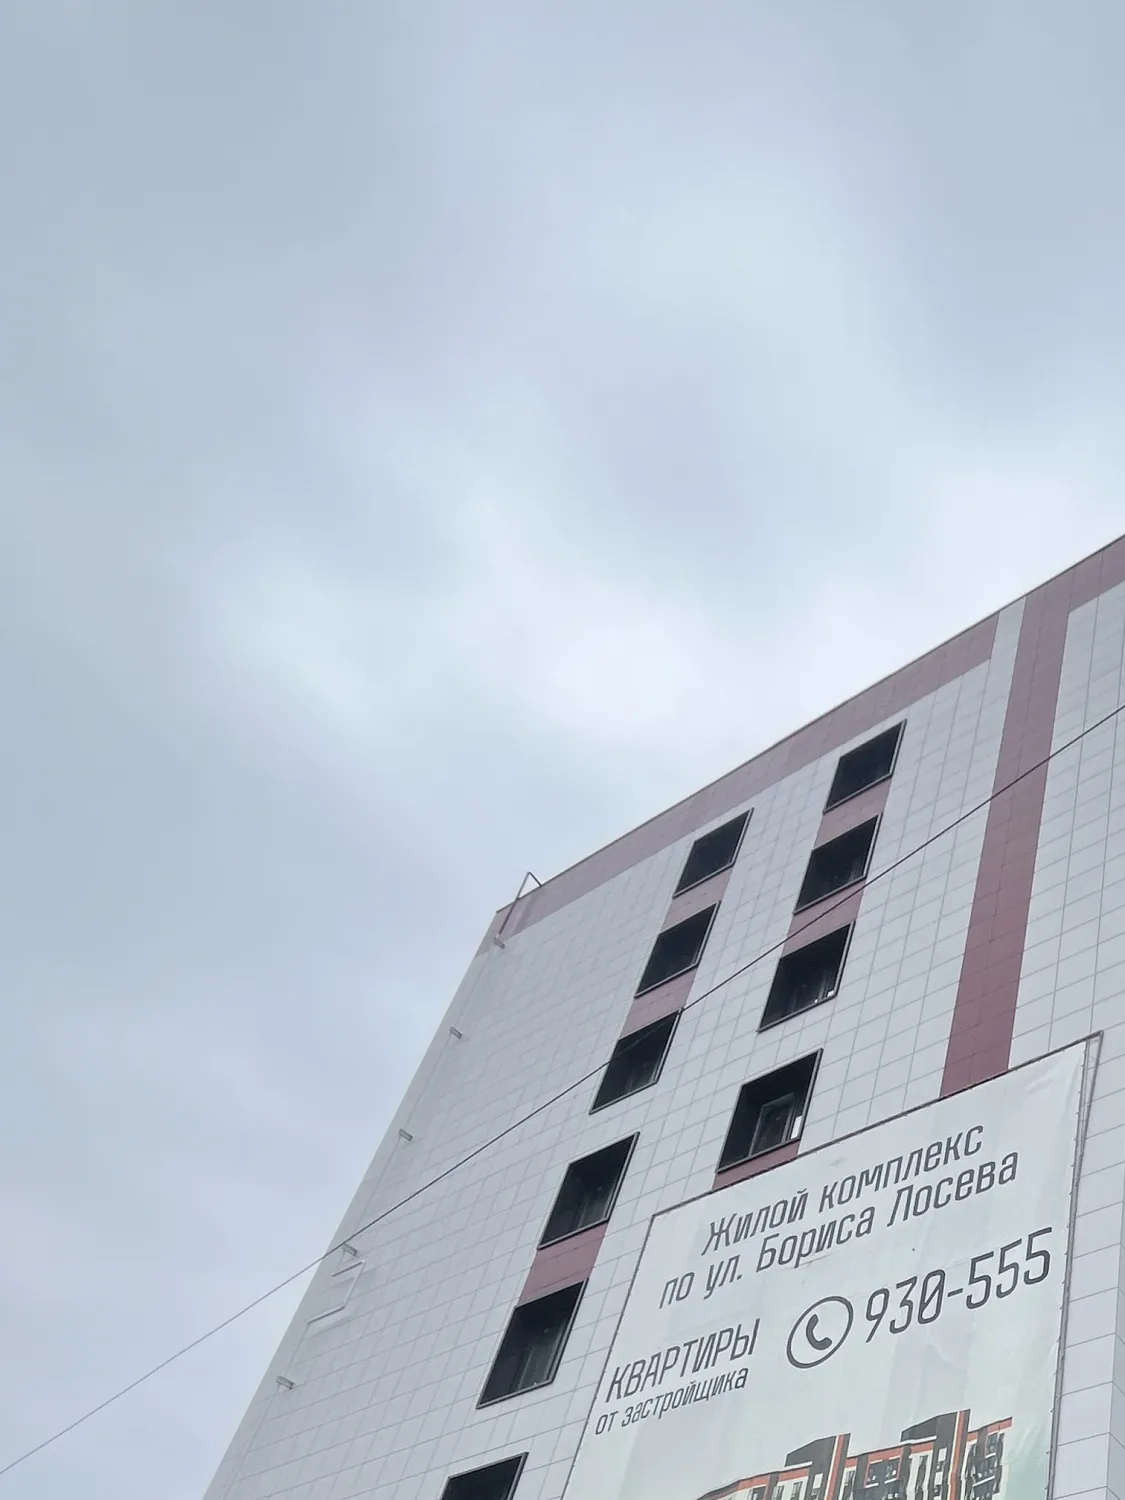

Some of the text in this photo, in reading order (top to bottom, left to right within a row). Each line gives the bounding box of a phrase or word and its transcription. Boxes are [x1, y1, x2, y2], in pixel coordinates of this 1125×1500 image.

[659, 1152, 1019, 1309] по ул. Бориса Лосева
[701, 1125, 984, 1257] Жилой комплекс
[865, 1226, 1053, 1344] 930-555
[595, 1367, 749, 1436] от застройщика
[604, 1318, 761, 1404] КВАРТИРЫ
